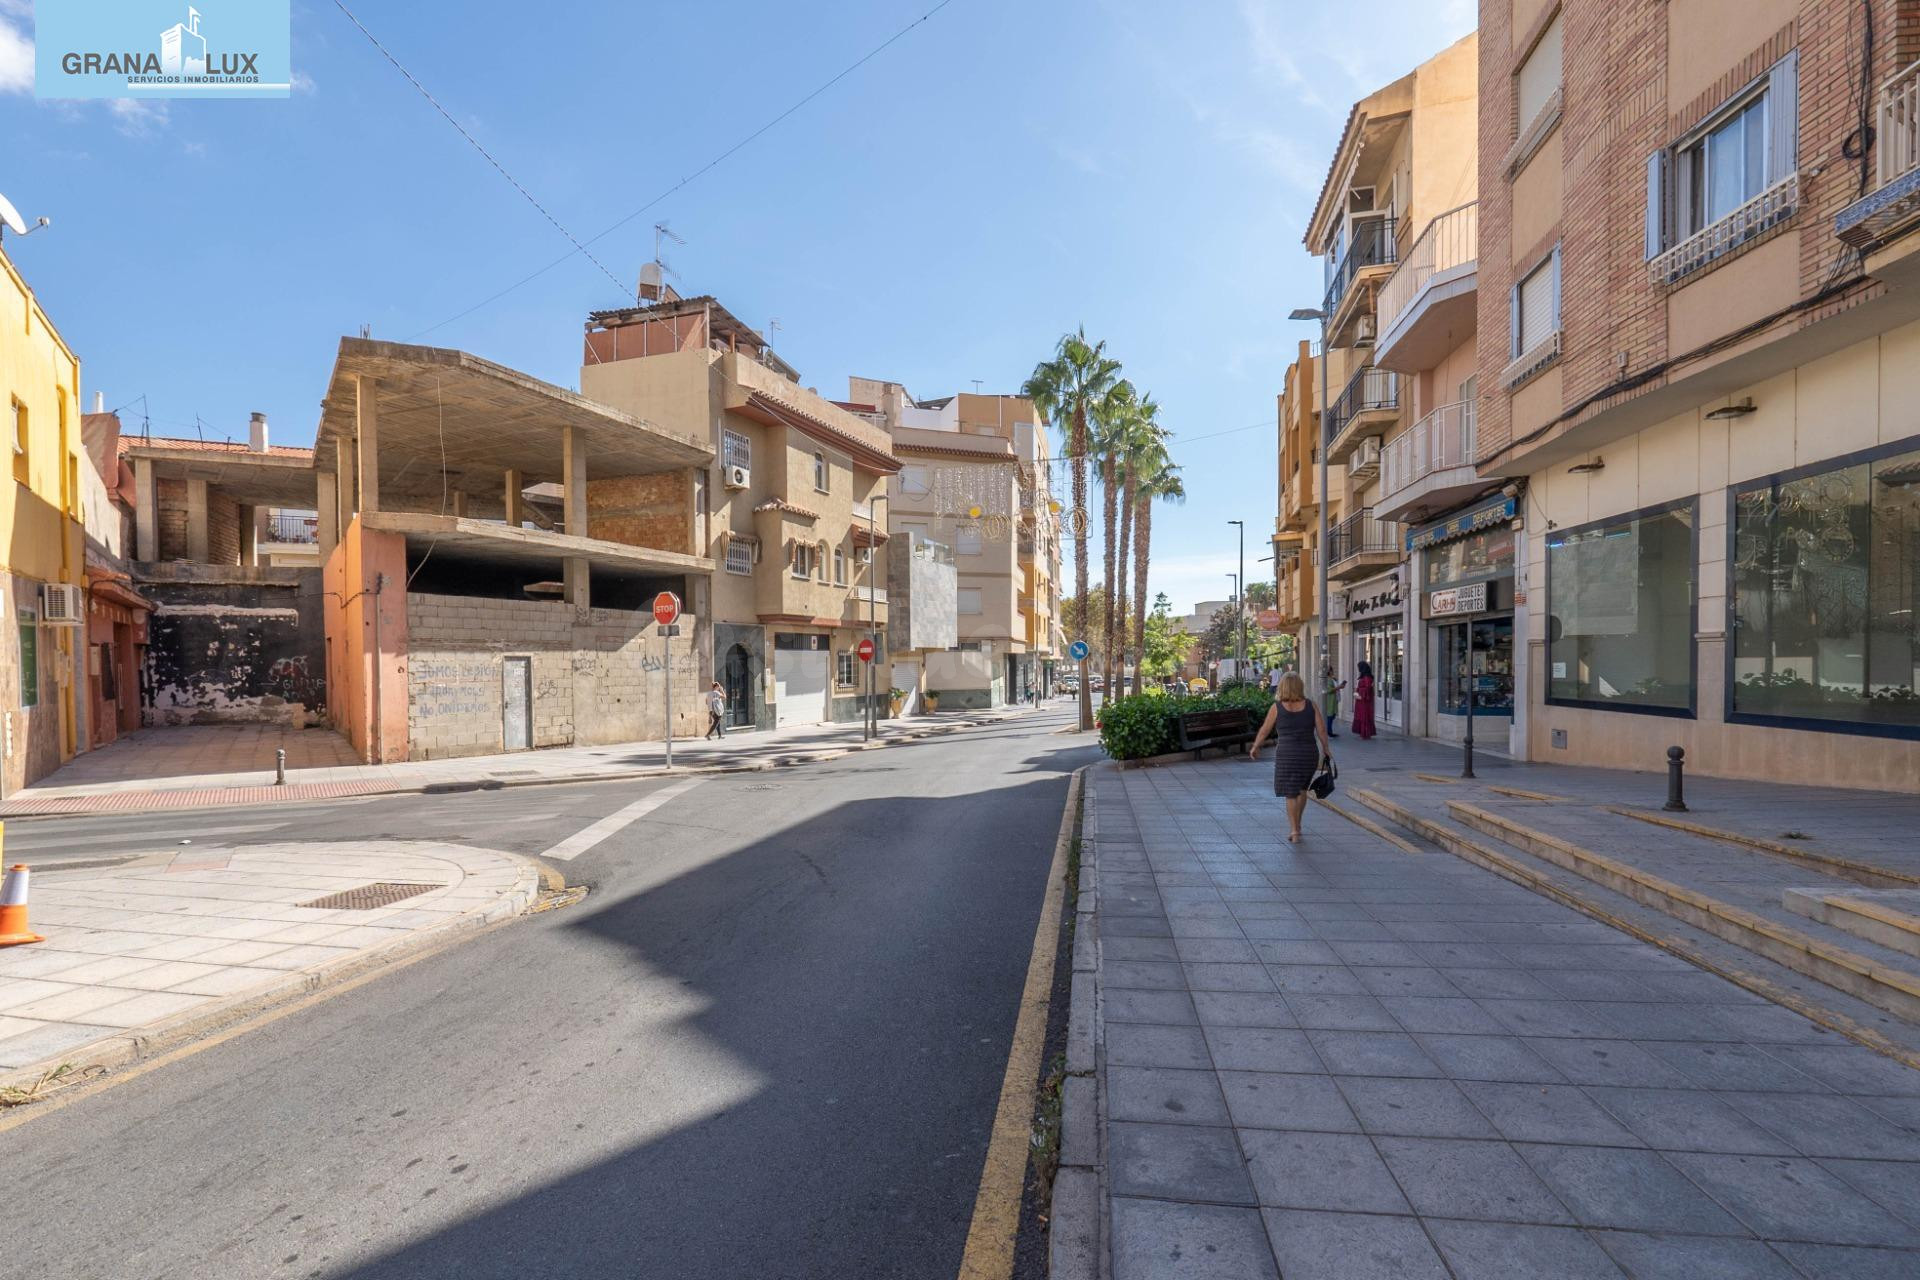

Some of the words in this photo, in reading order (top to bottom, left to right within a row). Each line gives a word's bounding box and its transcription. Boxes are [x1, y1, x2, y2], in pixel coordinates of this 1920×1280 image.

[1458, 584, 1484, 599] JUGUETES
[655, 604, 674, 613] STOP
[1458, 598, 1484, 611] DEPORTES
